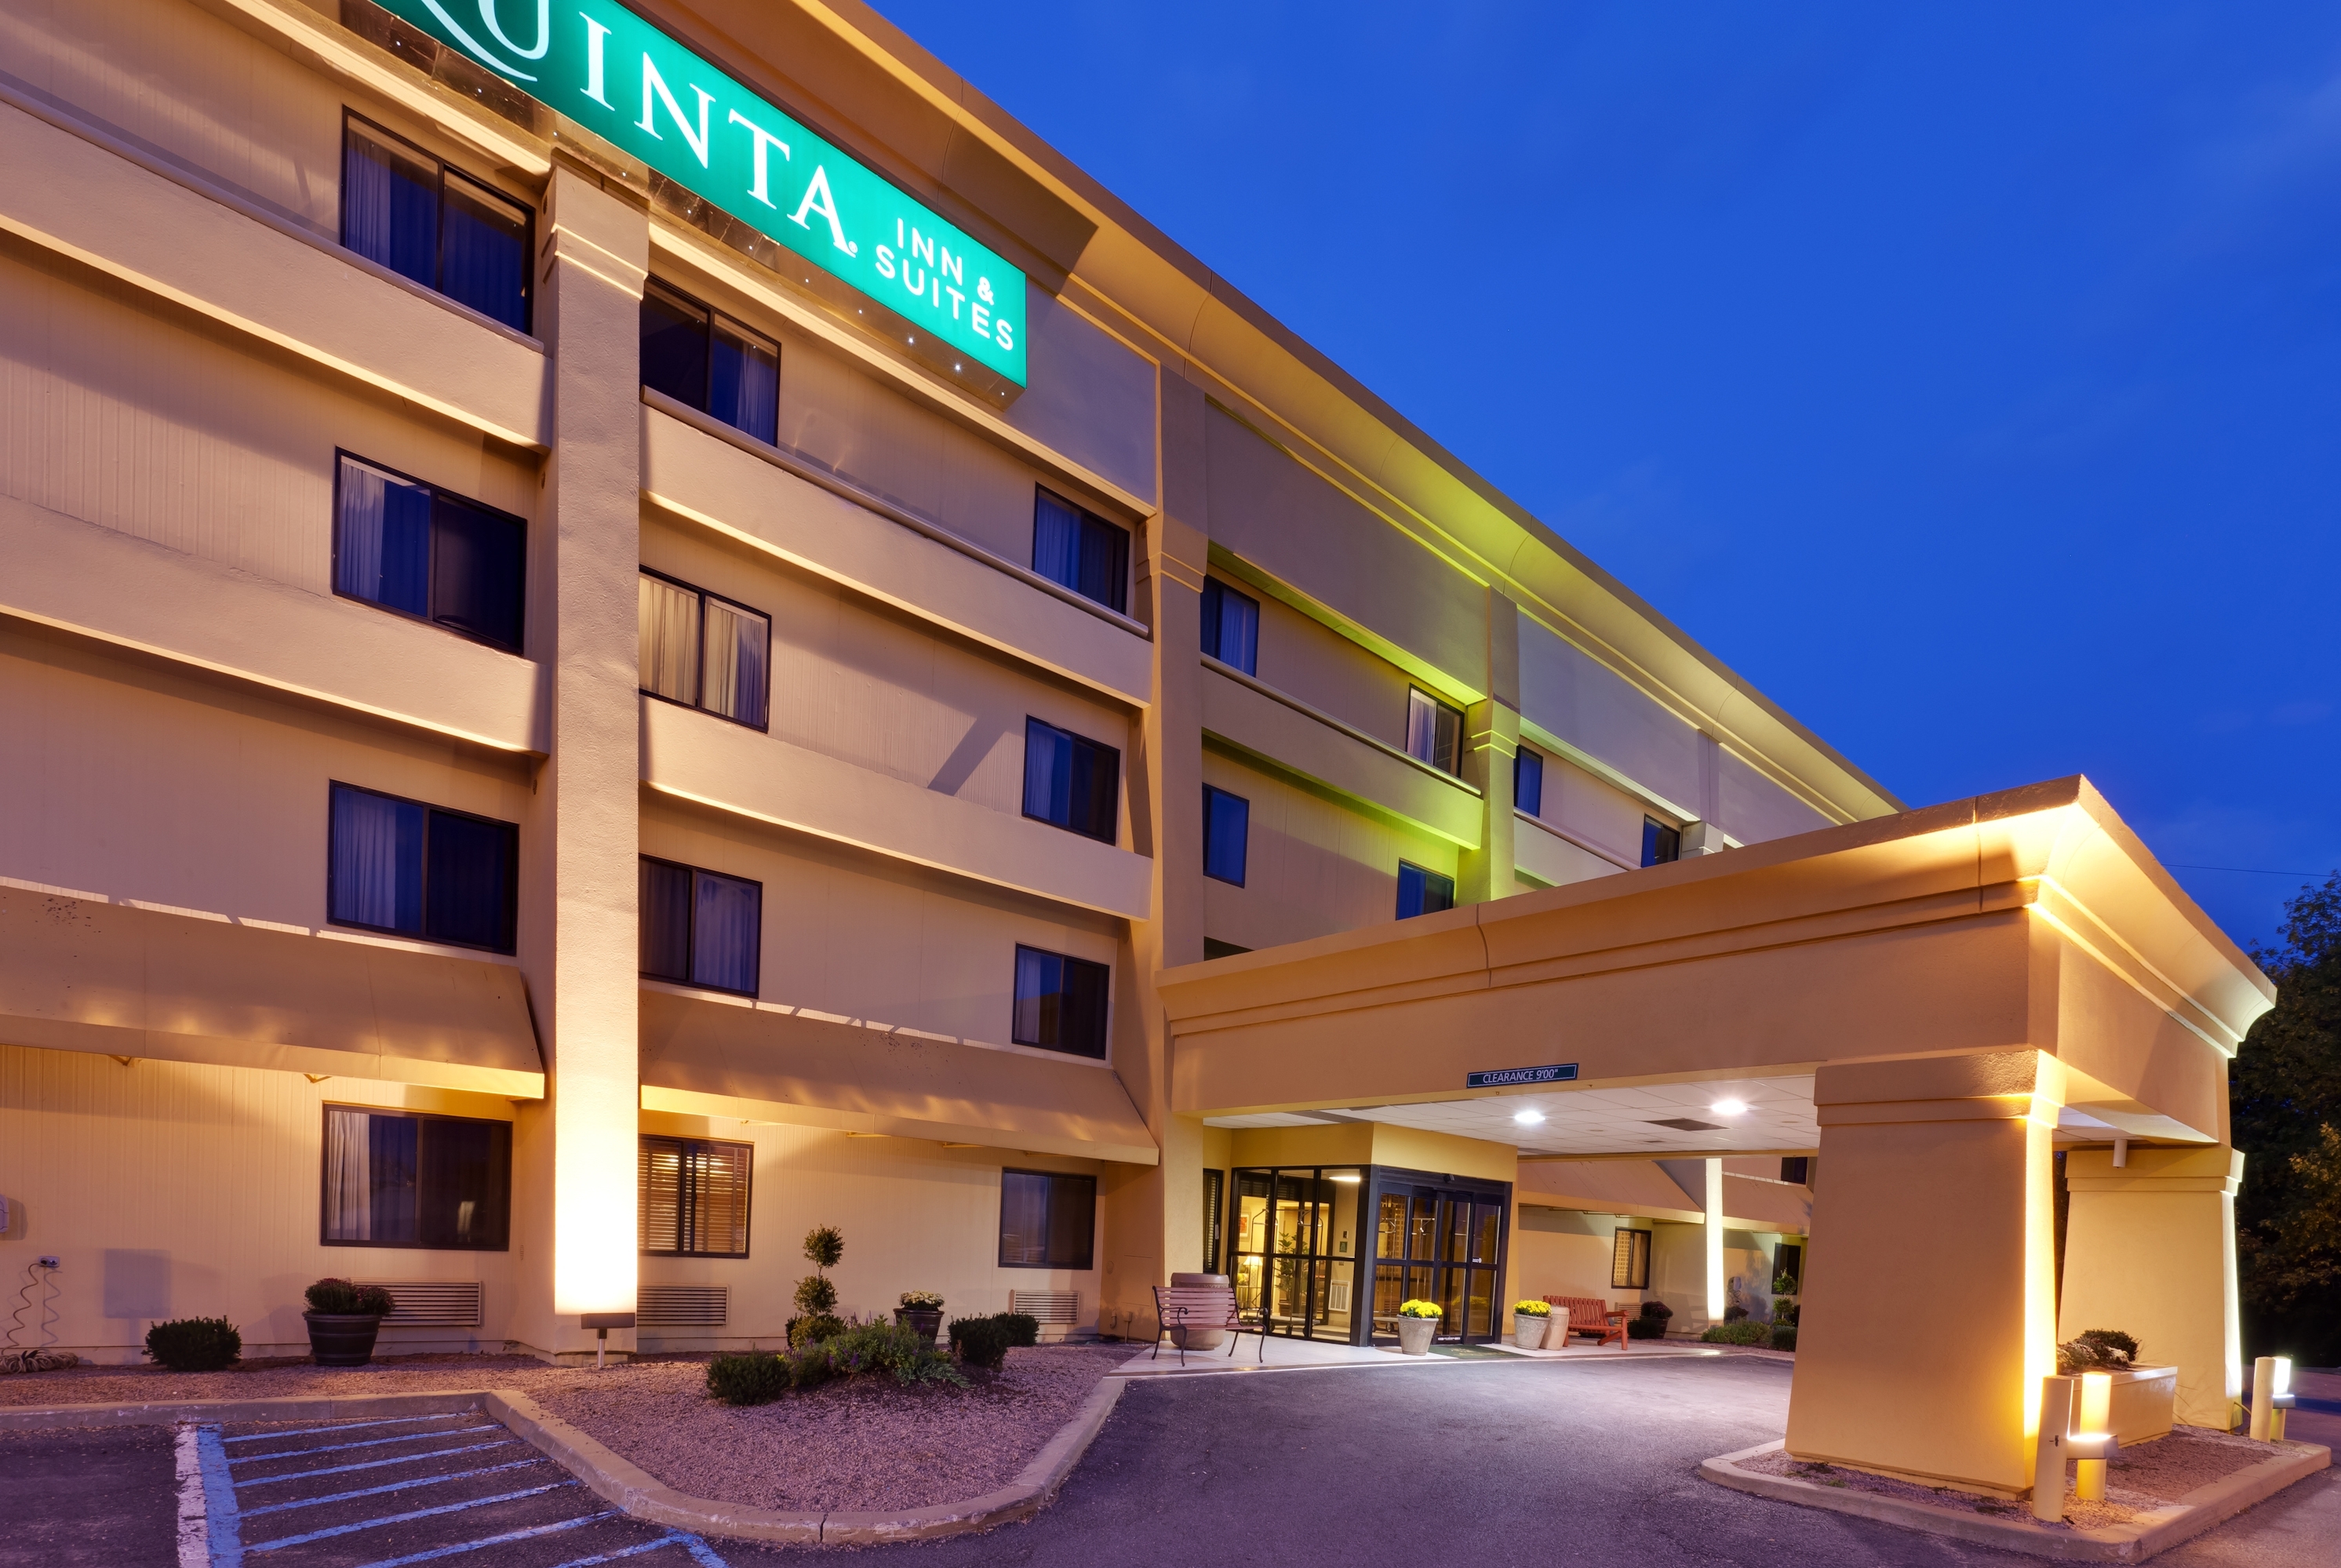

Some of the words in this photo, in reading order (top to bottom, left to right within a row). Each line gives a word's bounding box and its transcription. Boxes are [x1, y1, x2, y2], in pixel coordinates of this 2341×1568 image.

[421, 0, 857, 259] UINTA
[875, 244, 1014, 351] SUITES
[897, 217, 963, 286] INN
[977, 276, 995, 306] &
[1483, 1071, 1535, 1084] CLEARANCE
[1536, 1068, 1559, 1079] 9'00"
